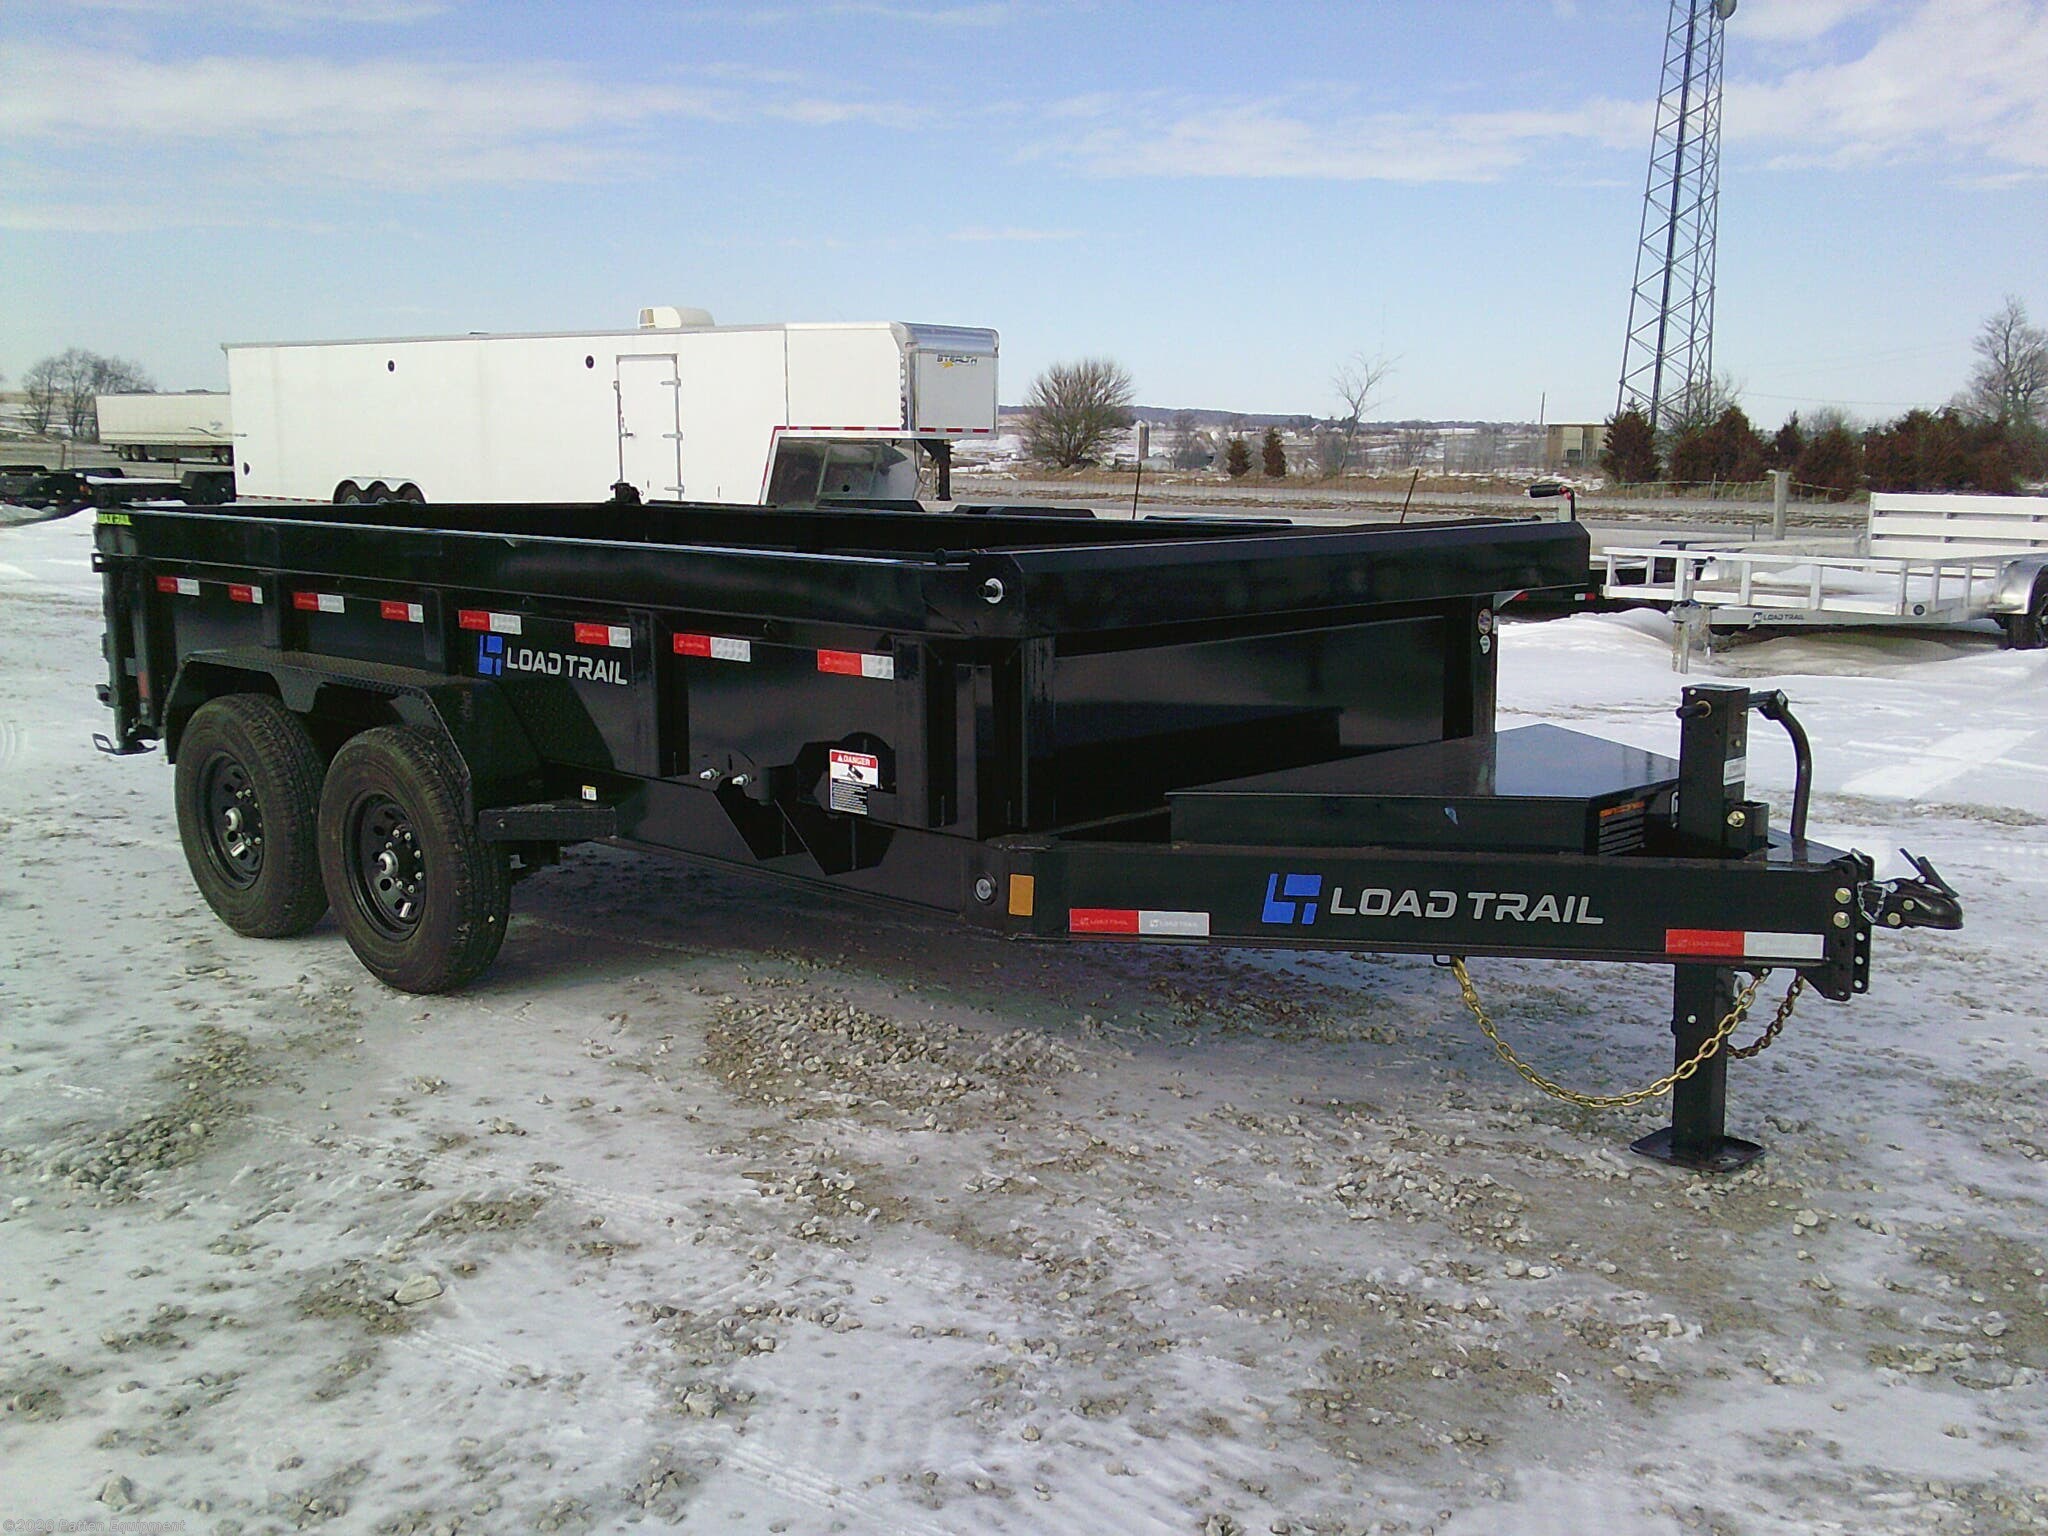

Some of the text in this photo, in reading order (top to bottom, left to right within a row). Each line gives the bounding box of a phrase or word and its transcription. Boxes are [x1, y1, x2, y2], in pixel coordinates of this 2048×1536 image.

[506, 646, 562, 675] LOAD
[565, 654, 628, 685] TRAIL
[843, 754, 871, 767] DANGER
[1330, 887, 1458, 918] LOAD
[1467, 892, 1604, 925] TRAIL
